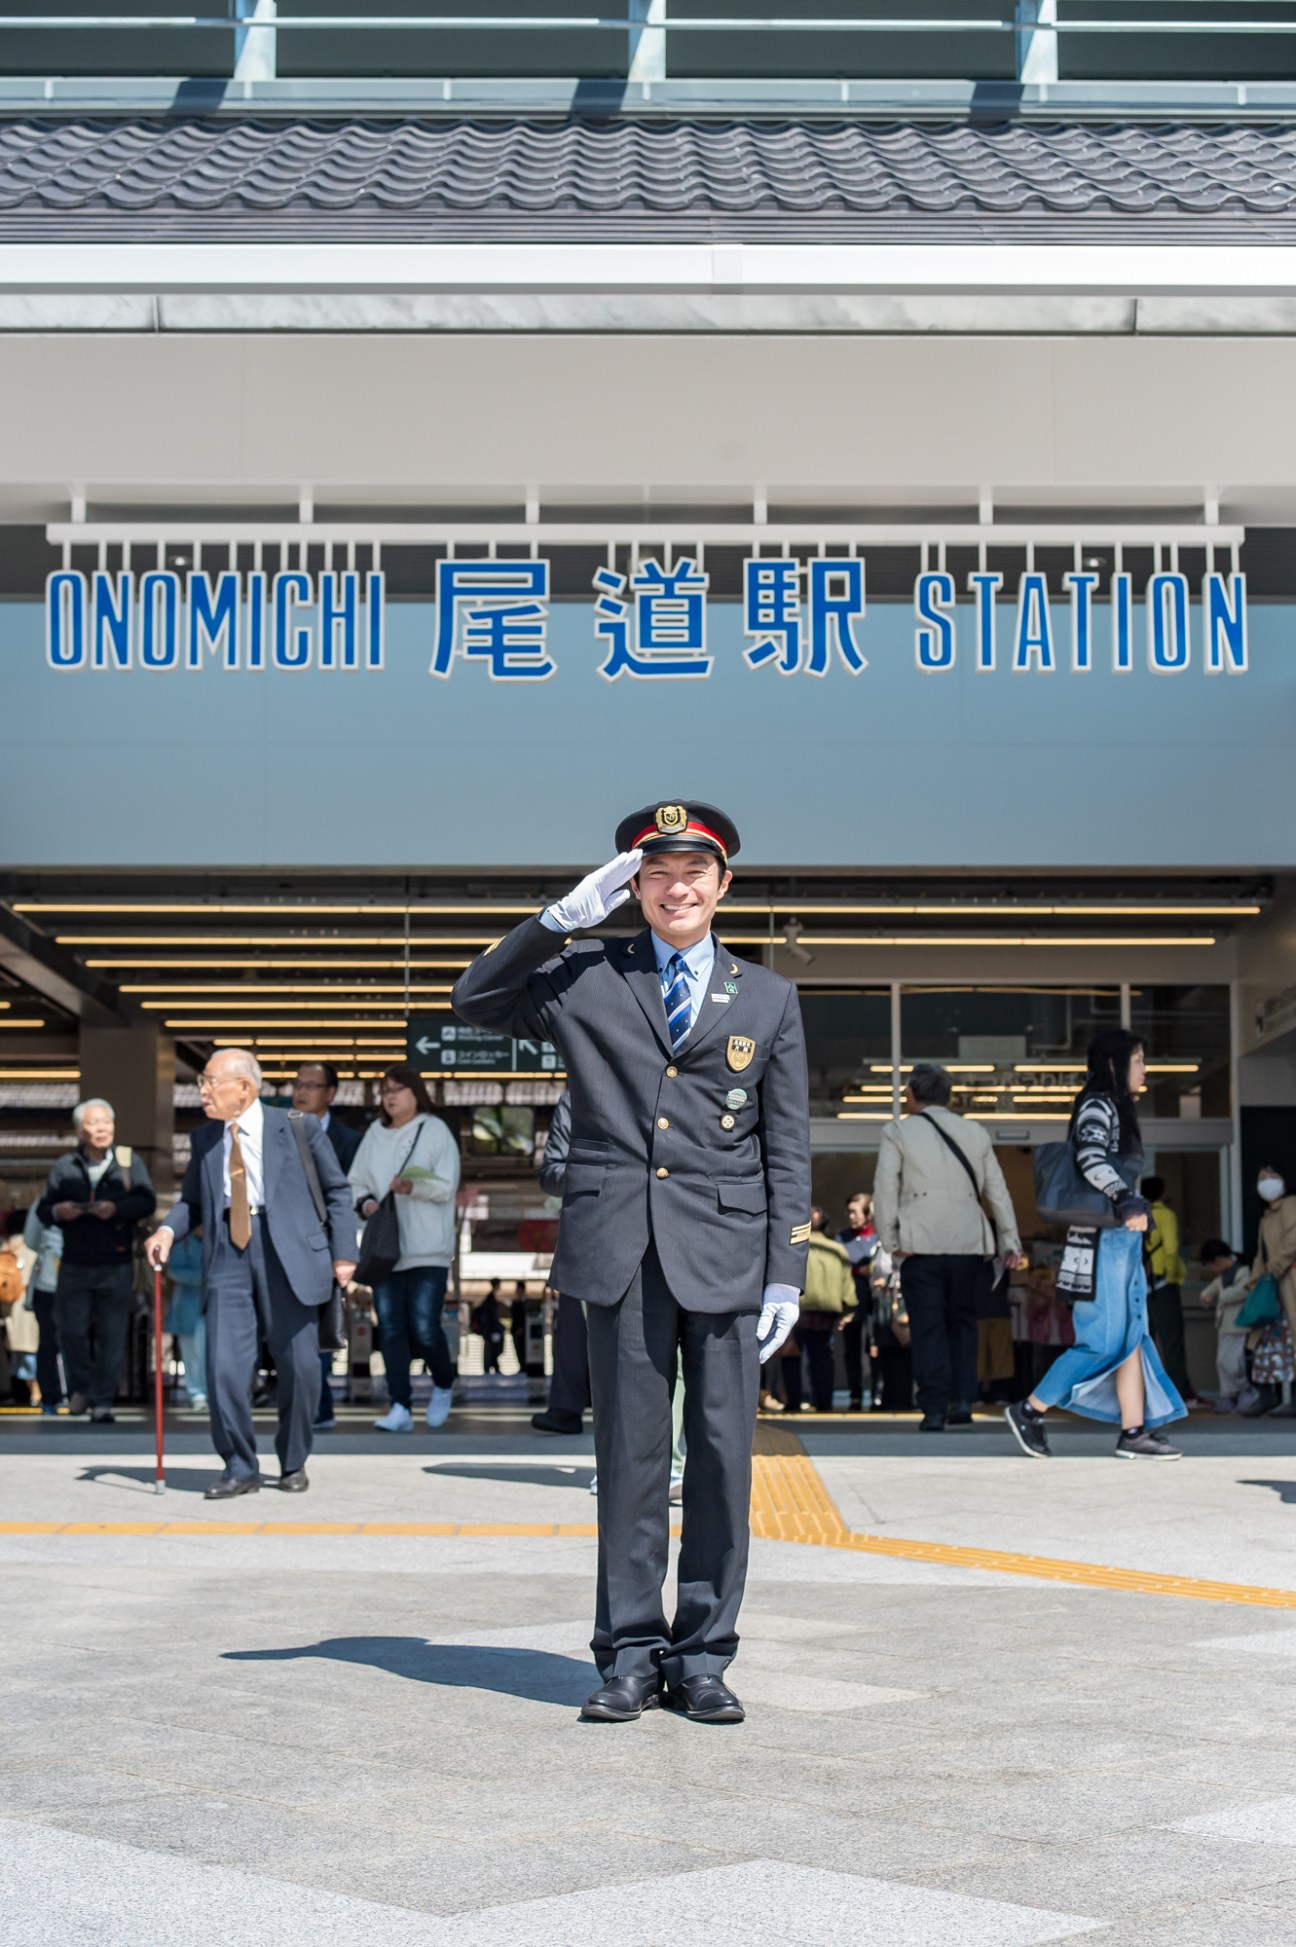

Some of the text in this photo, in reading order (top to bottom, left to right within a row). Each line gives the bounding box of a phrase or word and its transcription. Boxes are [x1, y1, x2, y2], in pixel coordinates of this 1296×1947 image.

[46, 557, 1248, 681] ONOMICHI 尾道駅 STATION
